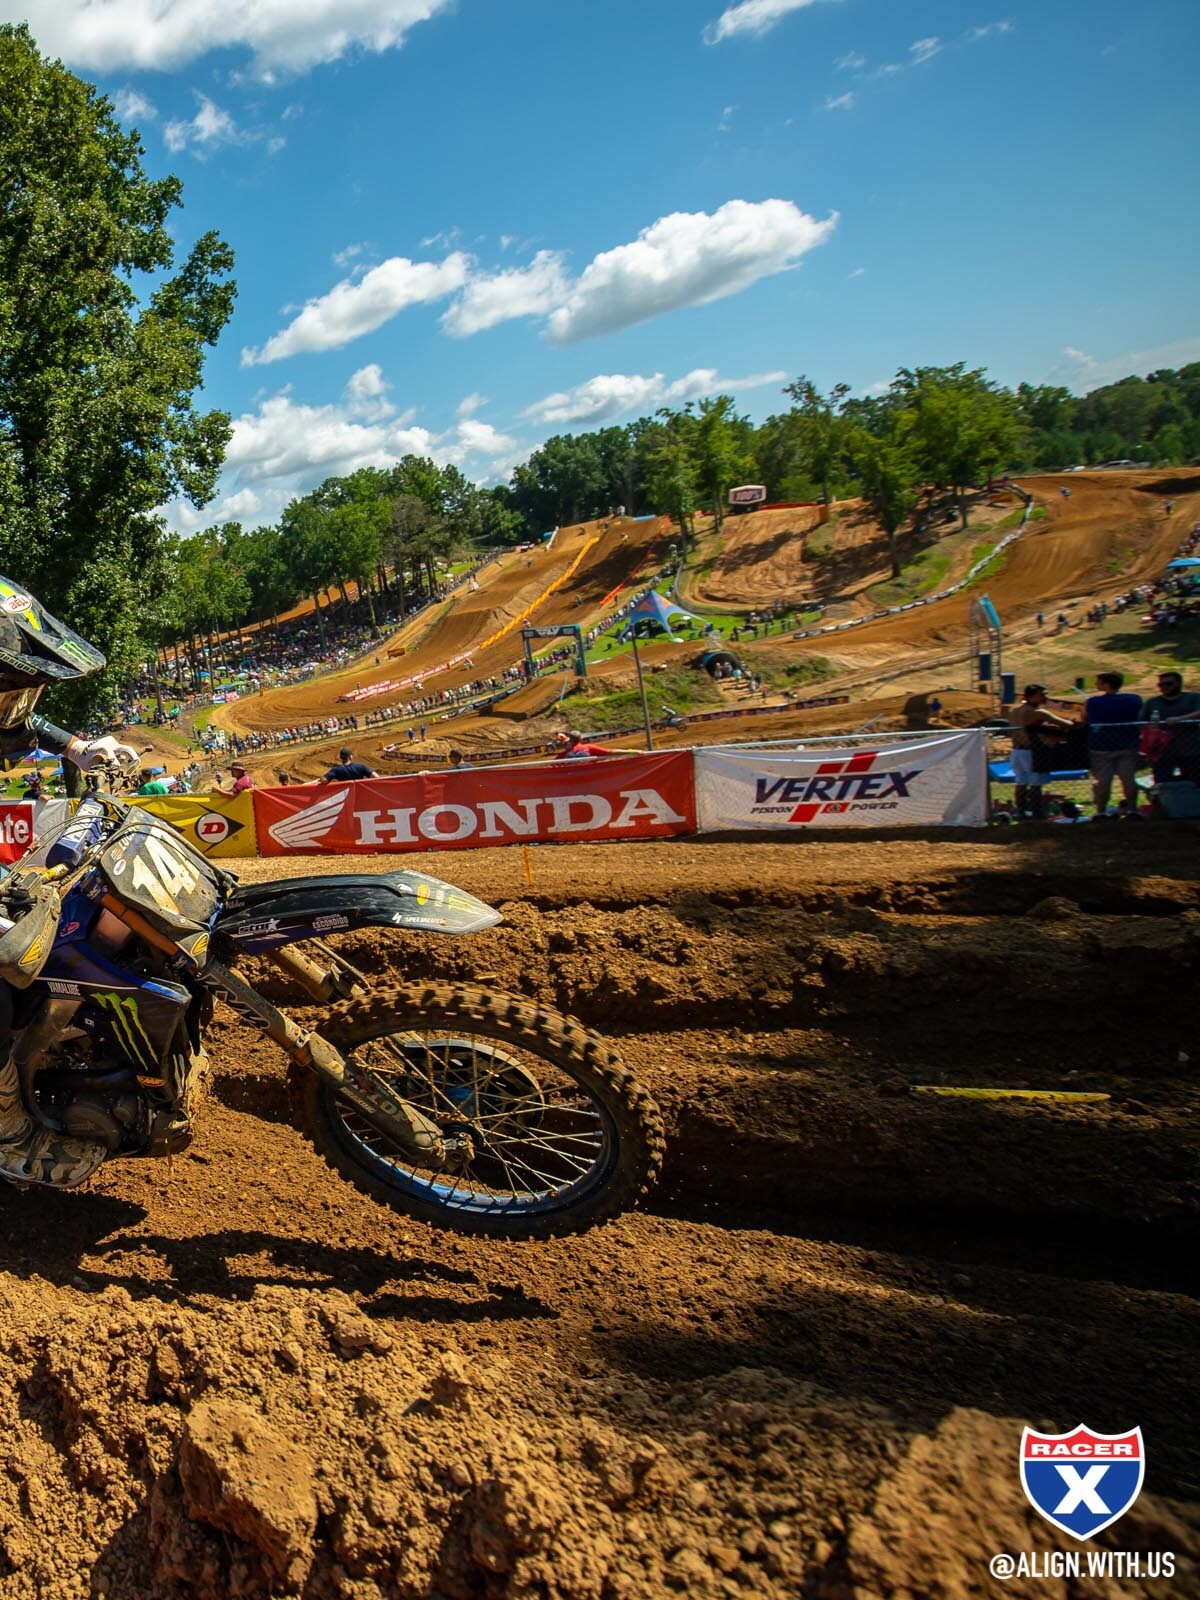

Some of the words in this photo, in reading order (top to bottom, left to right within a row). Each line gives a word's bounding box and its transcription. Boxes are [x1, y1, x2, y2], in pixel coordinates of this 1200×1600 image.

[755, 770, 923, 803] VERTEX
[352, 788, 687, 845] HONDA
[751, 805, 795, 814] PISTON
[850, 801, 899, 811] POWER
